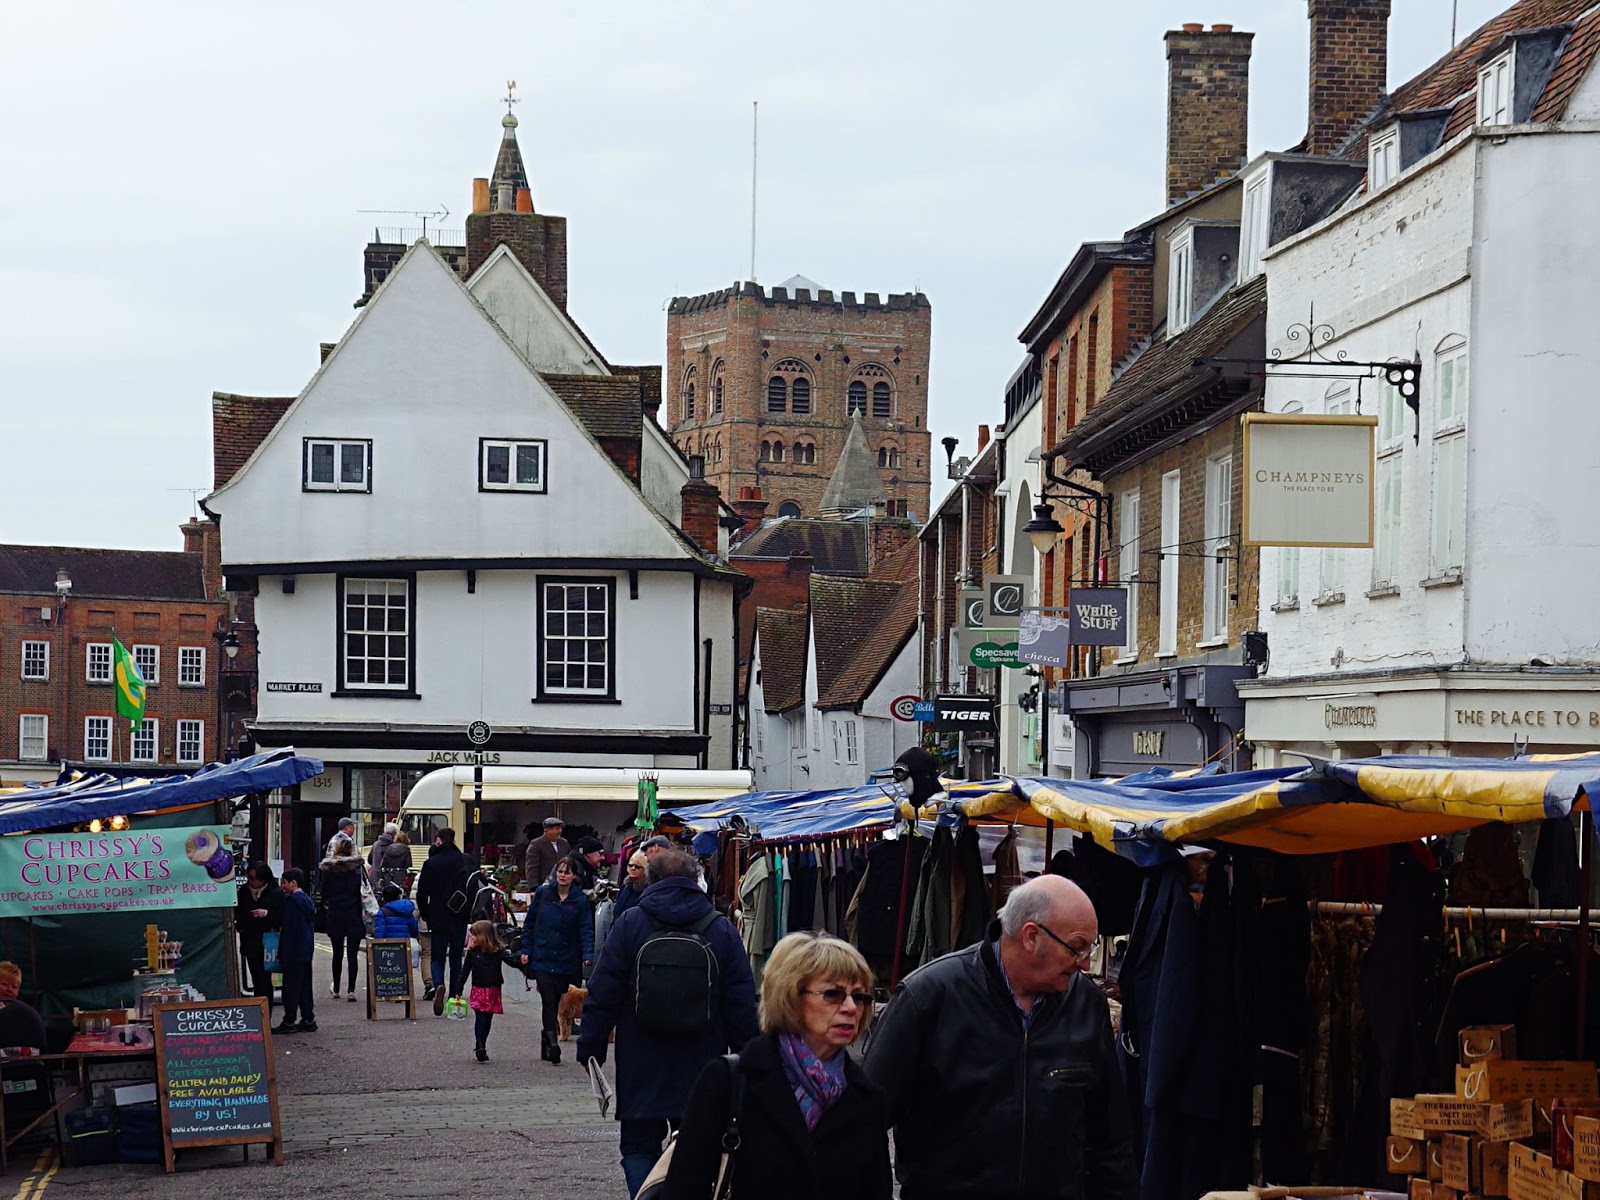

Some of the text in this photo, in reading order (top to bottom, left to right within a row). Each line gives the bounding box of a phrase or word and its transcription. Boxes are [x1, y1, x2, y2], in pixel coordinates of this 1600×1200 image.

[1255, 469, 1364, 484] CHAMPNEYS
[1024, 652, 1061, 664] chesca
[268, 683, 322, 692] MARKET PLACE
[940, 710, 991, 721] TIGER
[1454, 709, 1484, 725] THE
[1490, 709, 1546, 726] PLACE
[1552, 710, 1581, 726] TO
[427, 752, 501, 763] JACK WLS
[313, 777, 332, 788] 13-15
[23, 833, 164, 861] CHRISSY'S
[20, 859, 172, 886] CUPCAKES
[0, 882, 218, 902] UPCAKES CAKE POPS TRAY BAKES
[31, 897, 175, 912] www.chrissys-cupcakes.co.uk
[178, 1020, 246, 1032] CUPCAKES
[166, 1060, 187, 1068] ALL
[168, 1068, 212, 1078] CATERED
[217, 1066, 239, 1075] FOR
[169, 1073, 261, 1088] GLUTEN AND DAIRY
[169, 1086, 256, 1097] FREE AVAILABLE
[169, 1095, 269, 1109] EVERYTHING HANDMADE
[195, 1107, 238, 1121] BY US!
